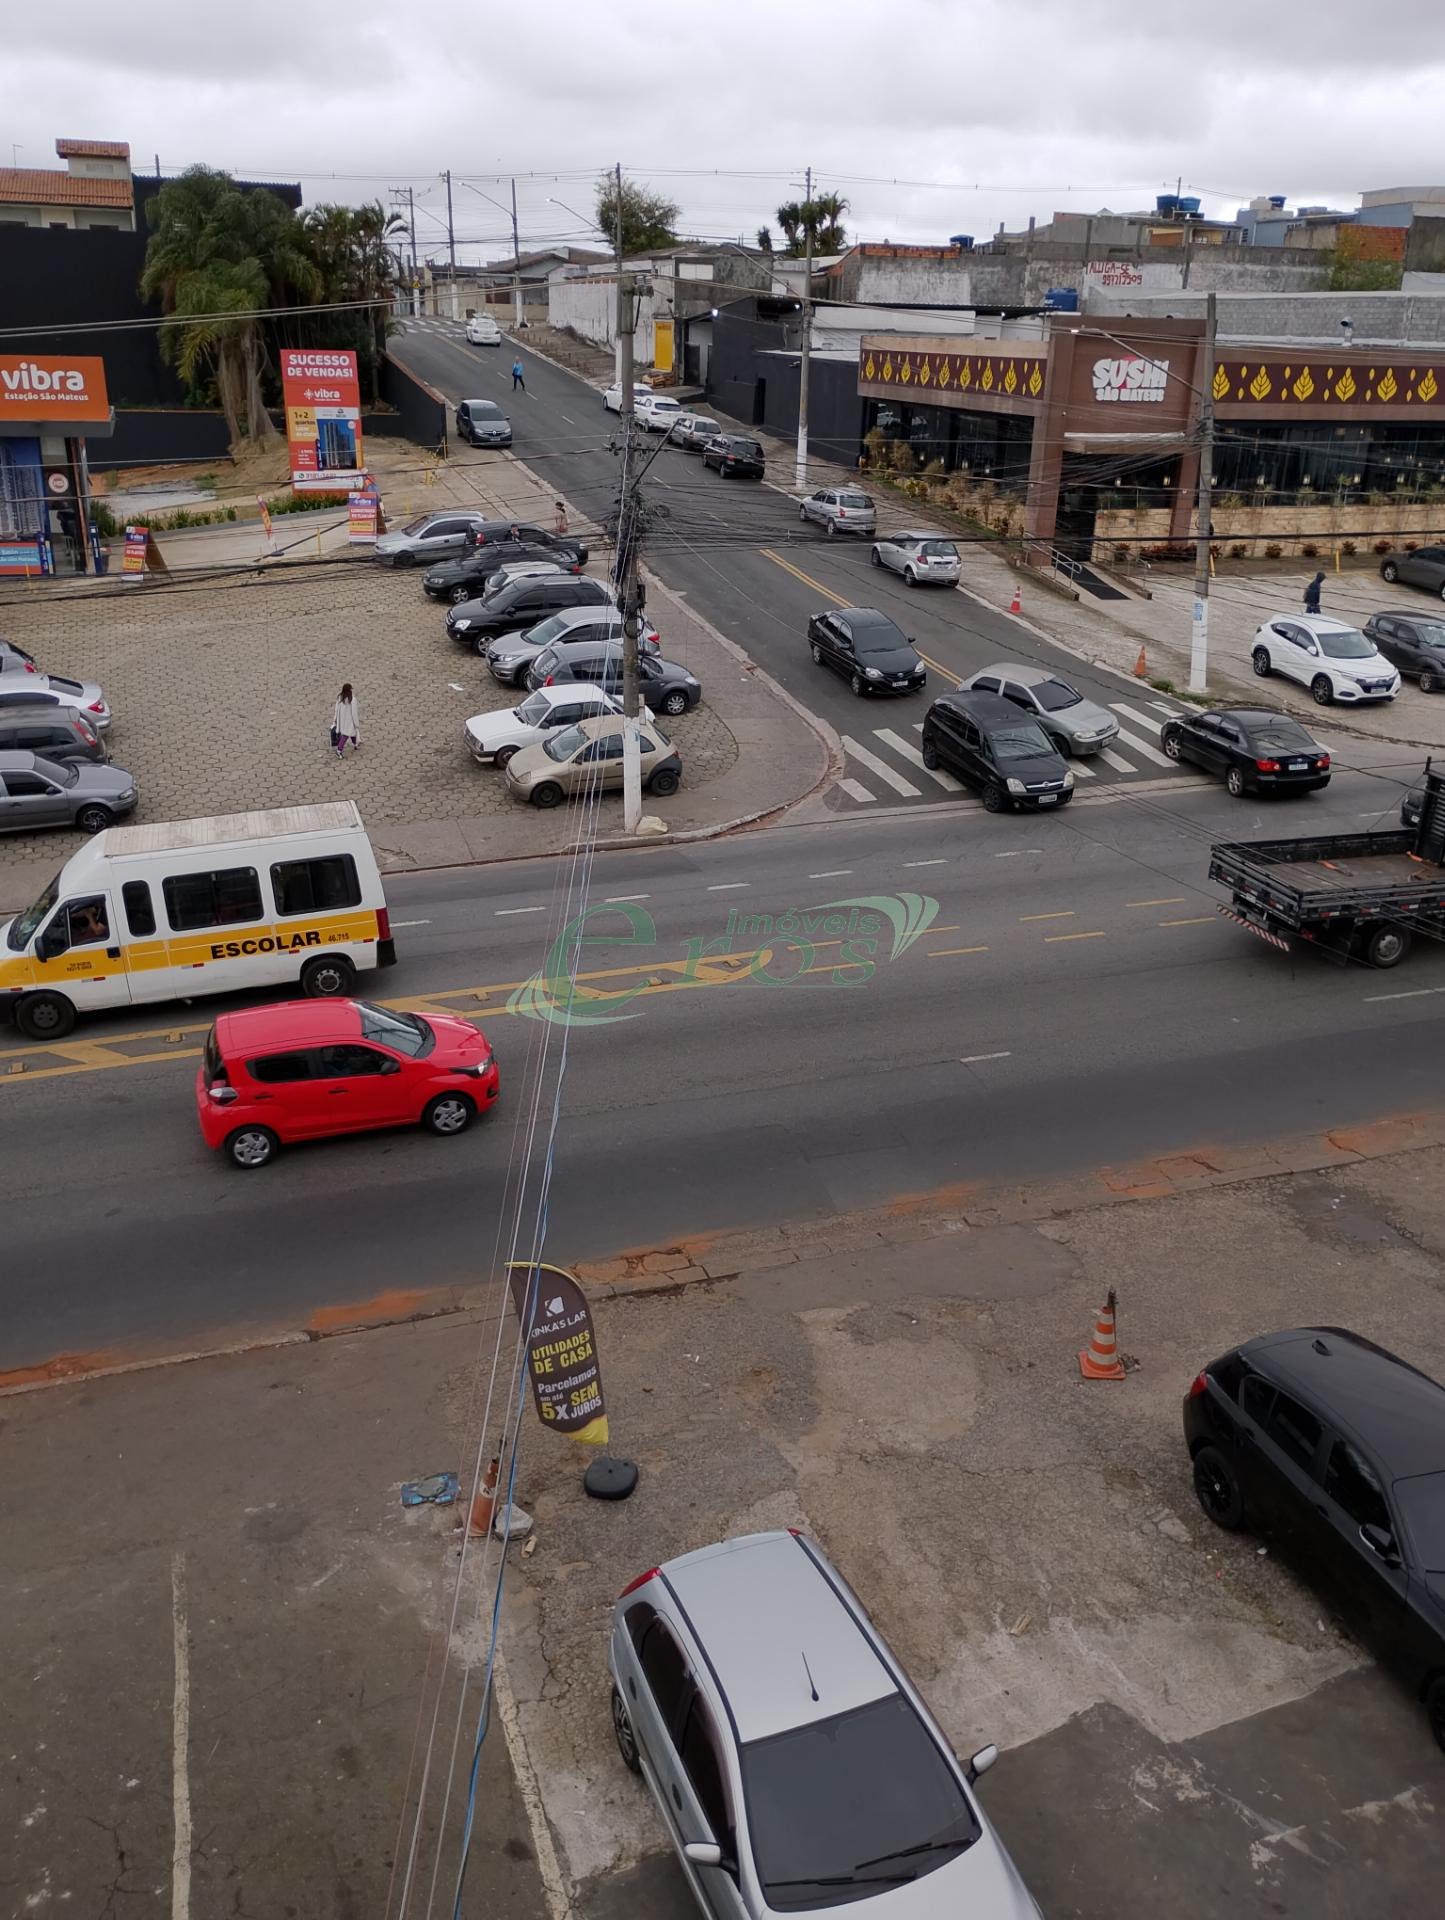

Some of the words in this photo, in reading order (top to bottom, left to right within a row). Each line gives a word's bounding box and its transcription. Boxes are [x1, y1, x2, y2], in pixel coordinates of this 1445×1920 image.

[287, 367, 303, 376] DE
[304, 368, 353, 377] VENDAS!
[289, 354, 350, 366] SUCESSO
[1, 362, 84, 391] vibra
[1093, 359, 1170, 389] SUSHI
[4, 392, 39, 401] Estação
[40, 392, 56, 400] São
[58, 393, 89, 401] Mateus
[314, 388, 340, 398] vibra
[210, 931, 322, 960] ESCOLAR
[567, 1310, 587, 1326] LAR
[532, 1329, 591, 1361] UTILIDADES
[534, 1361, 554, 1374] DE
[560, 1343, 593, 1368] CASA
[538, 1366, 597, 1394] Parcelamos
[570, 1395, 602, 1419] JUROS
[571, 1381, 599, 1407] SEM
